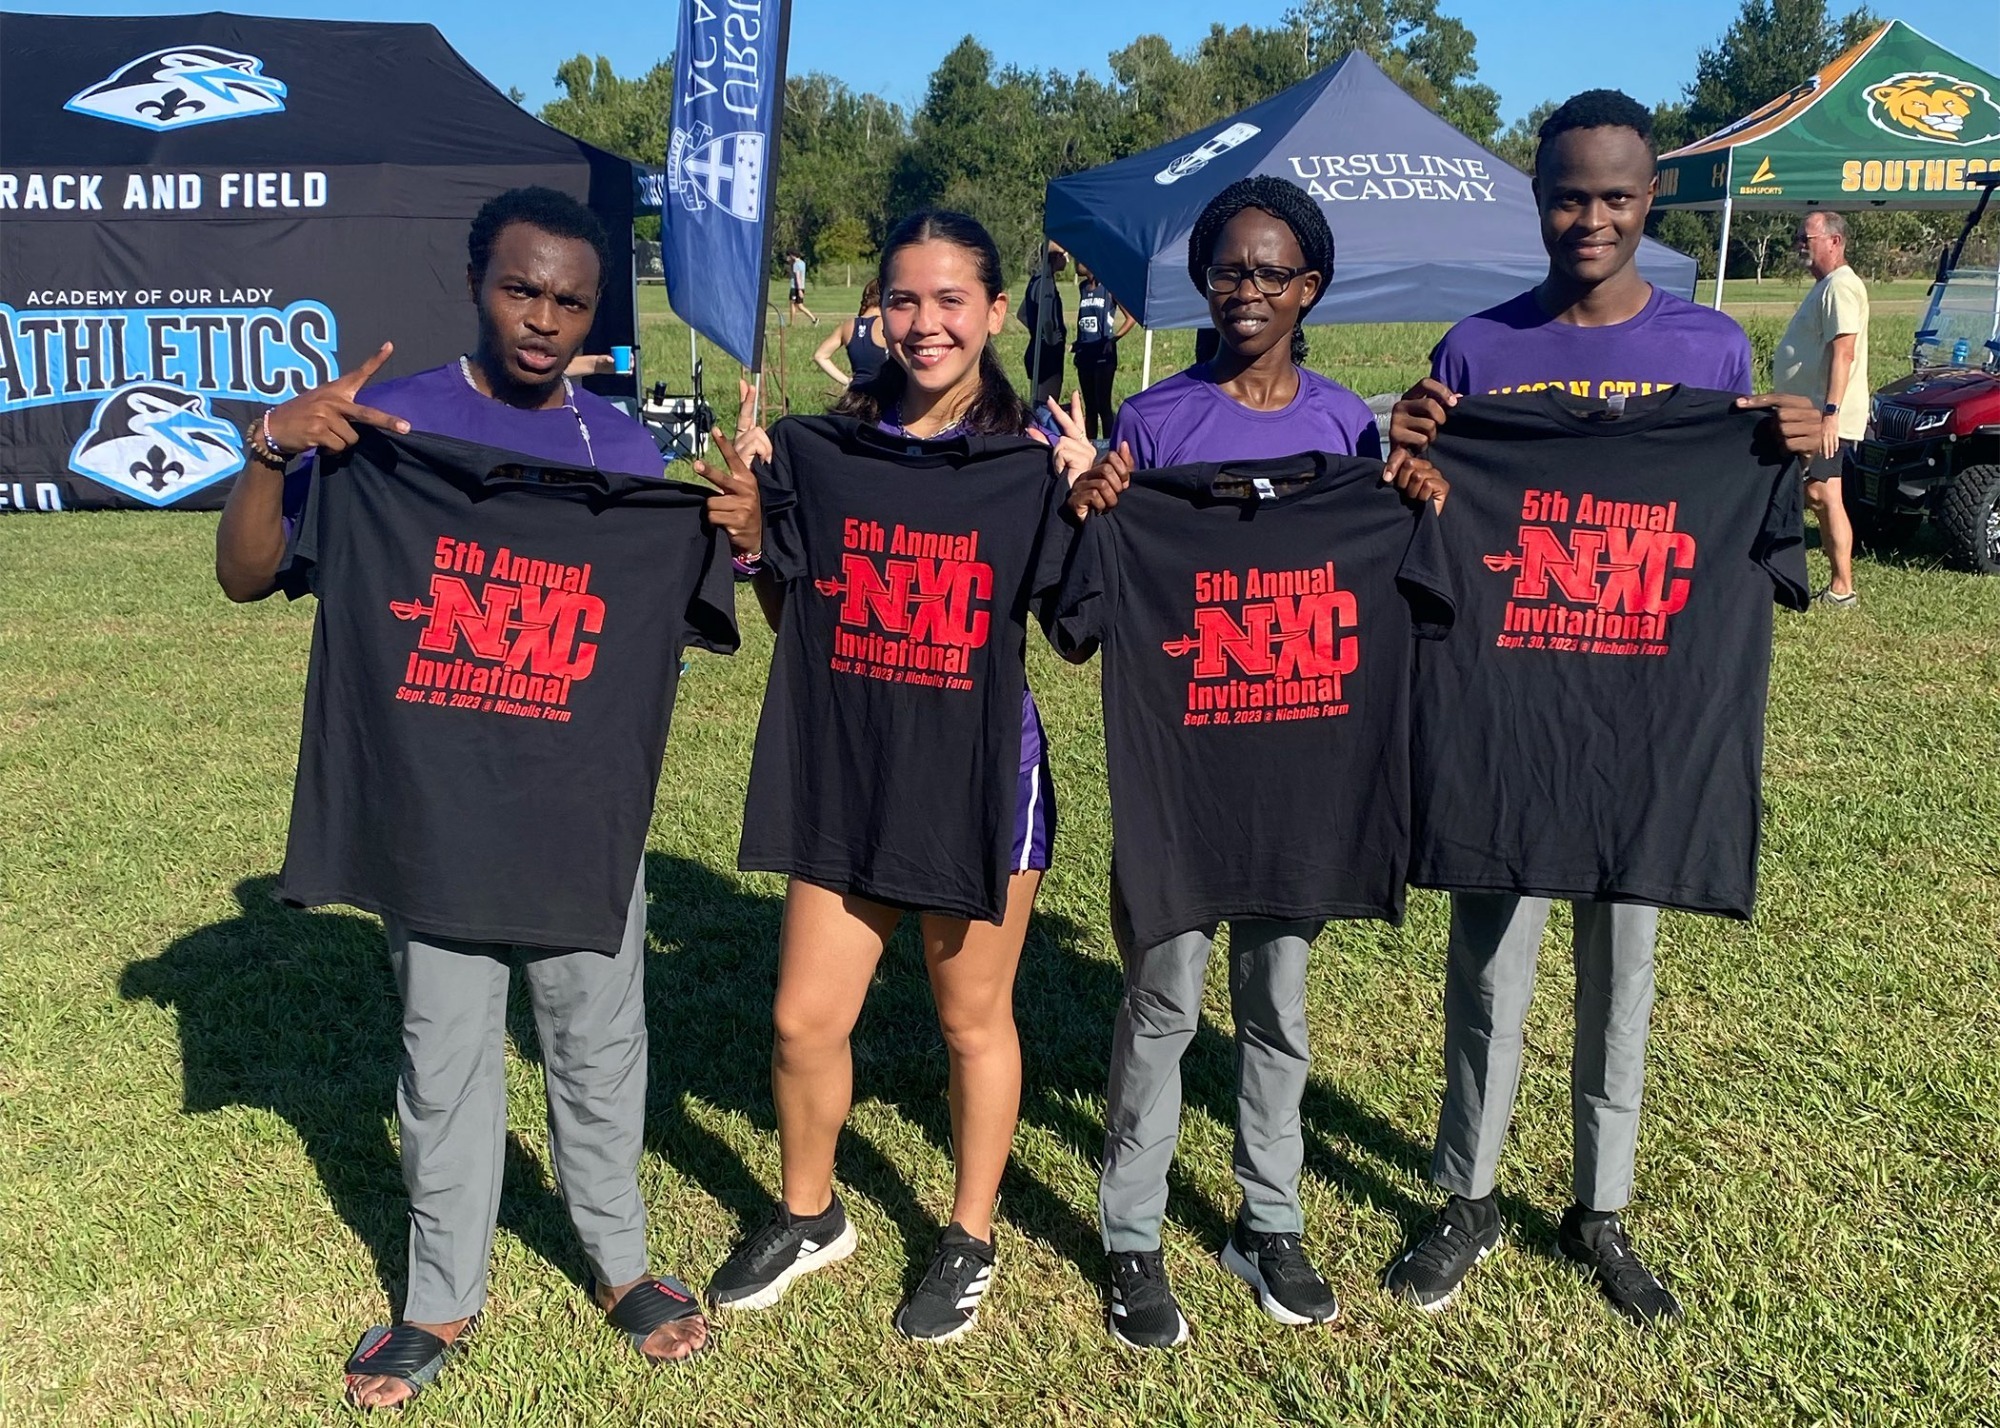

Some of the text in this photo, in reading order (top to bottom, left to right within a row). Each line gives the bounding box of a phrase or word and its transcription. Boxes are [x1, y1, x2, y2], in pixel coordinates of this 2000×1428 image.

[1288, 153, 1490, 180] URSULINE
[0, 172, 328, 210] RACK AND FIELD
[1307, 178, 1497, 202] ACADEMY
[26, 288, 274, 306] ACADEMY OF OUR LADY
[1521, 489, 1677, 532] 5th Annual
[843, 517, 979, 561] 5th Annual
[434, 535, 591, 594] 5th Annual
[1195, 561, 1335, 603] 5th Annual
[1512, 525, 1696, 615] NXC
[840, 553, 994, 648] NXC
[1503, 601, 1667, 640] Invitational
[418, 573, 606, 680] NXC
[1193, 590, 1359, 680] NXC
[1496, 634, 1525, 649] Sept.
[1527, 635, 1545, 650] 30,
[1548, 639, 1578, 652] 2023
[1591, 640, 1639, 656] Nicholls
[1640, 644, 1669, 656] Farm
[834, 626, 971, 674] Invitational
[404, 651, 572, 705] Invitational
[830, 657, 852, 674] Sept.
[854, 662, 868, 677] 30,
[869, 667, 893, 682] 2023
[904, 672, 944, 688] Nicholls
[945, 676, 973, 691] Farm
[1188, 670, 1342, 711] Invitational
[395, 686, 425, 704] Sept.
[428, 692, 447, 708] 30,
[449, 694, 481, 709] 2023
[493, 700, 541, 718] Nicholls
[542, 706, 572, 722] Farm
[1183, 712, 1211, 727] Sept.
[1213, 711, 1231, 725] 30,
[1234, 710, 1262, 723] 2023
[1275, 705, 1320, 721] Nicholls
[1322, 703, 1349, 715] Farm
